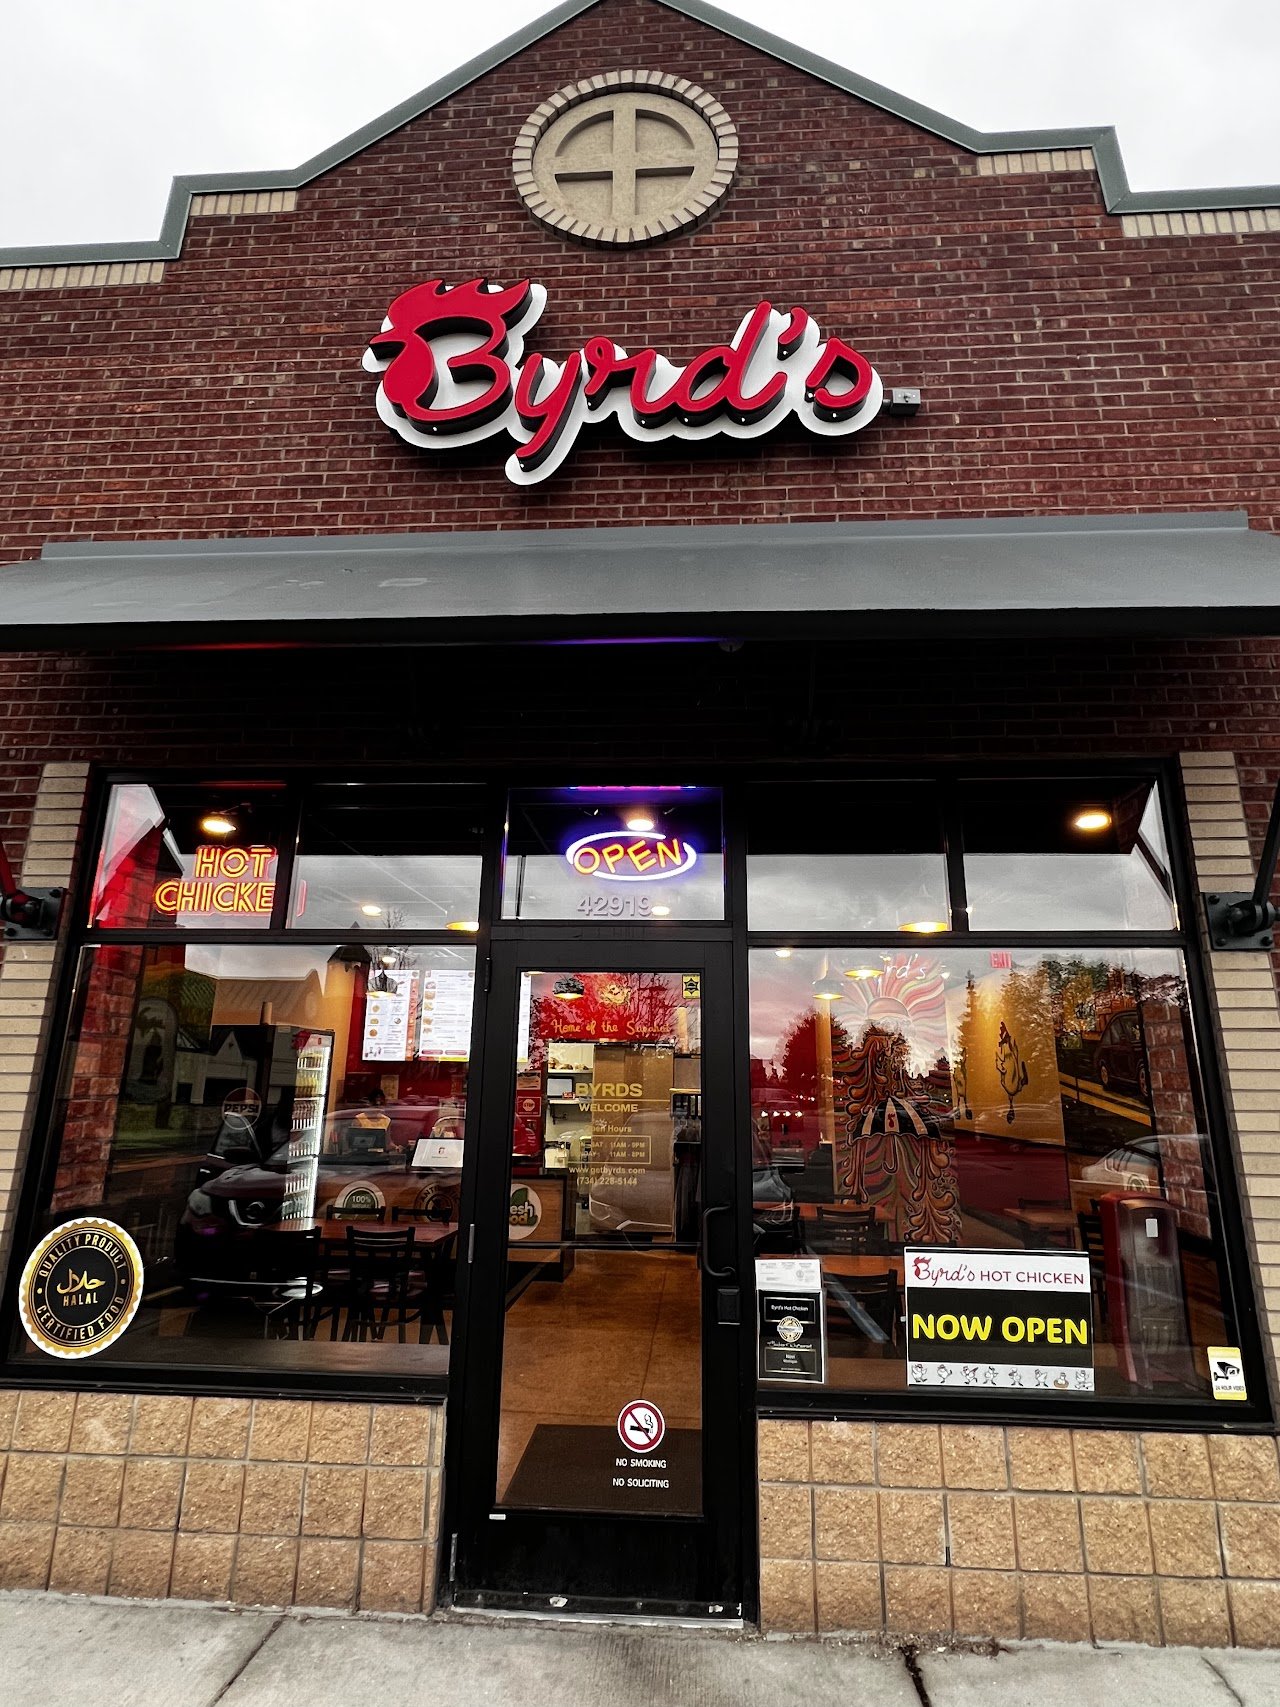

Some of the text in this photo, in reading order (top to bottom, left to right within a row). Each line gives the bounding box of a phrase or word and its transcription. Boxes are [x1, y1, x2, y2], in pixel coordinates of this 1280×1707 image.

[367, 277, 874, 472] Byrd's
[194, 847, 273, 878] HOT
[573, 838, 683, 875] OPEN
[154, 880, 276, 912] CHICKE
[577, 895, 652, 917] 42919
[552, 1020, 581, 1034] Home
[586, 1020, 597, 1035] of
[601, 1020, 619, 1033] the
[575, 1082, 643, 1097] BYRDS
[224, 1103, 260, 1113] PEPSI
[579, 1103, 639, 1113] WELCOME
[607, 1124, 632, 1133] Hours
[510, 1201, 534, 1218] esh
[38, 1233, 127, 1278] QUALITY PRODUCT
[56, 1268, 106, 1295] حلال
[912, 1256, 1084, 1287] Byrd's HOT CHICKEN
[62, 1292, 99, 1307] HALAL
[36, 1296, 125, 1341] CERTIFIED FOOD
[912, 1313, 1088, 1345] NOW OPEN
[615, 1458, 666, 1468] NO SMOKING
[612, 1478, 669, 1488] NO SOLICITING
